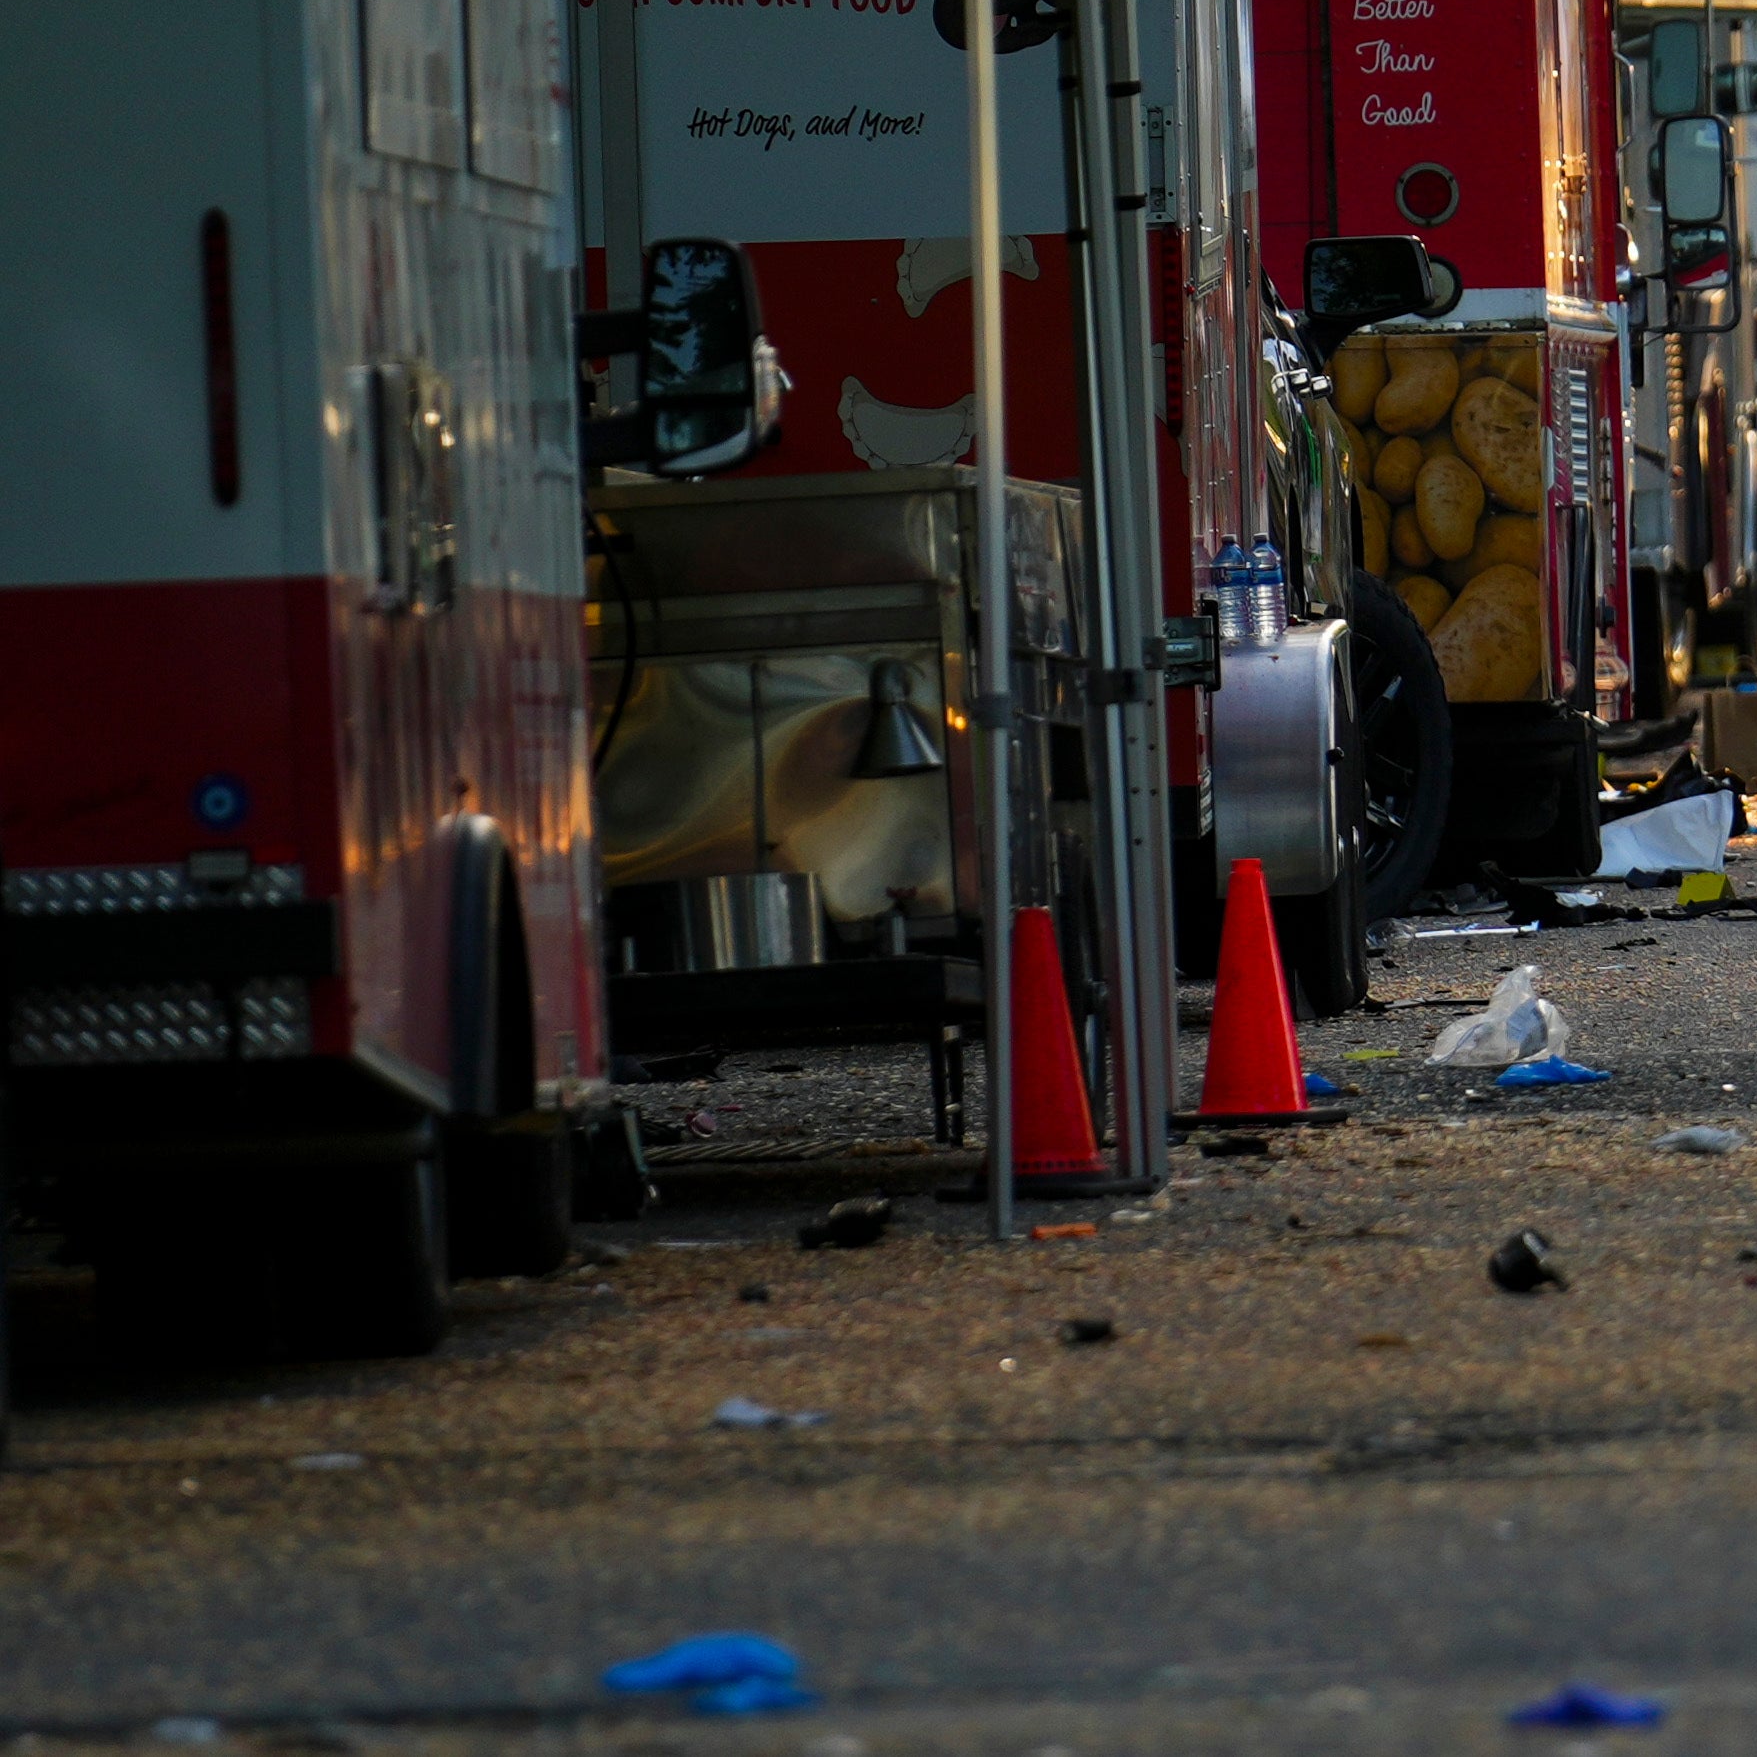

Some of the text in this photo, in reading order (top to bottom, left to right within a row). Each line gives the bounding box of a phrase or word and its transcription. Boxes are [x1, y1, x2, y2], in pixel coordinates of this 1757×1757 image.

[1355, 39, 1436, 74] Than
[1361, 91, 1437, 127] Good
[687, 105, 925, 151] Hot Dogs, and More!
